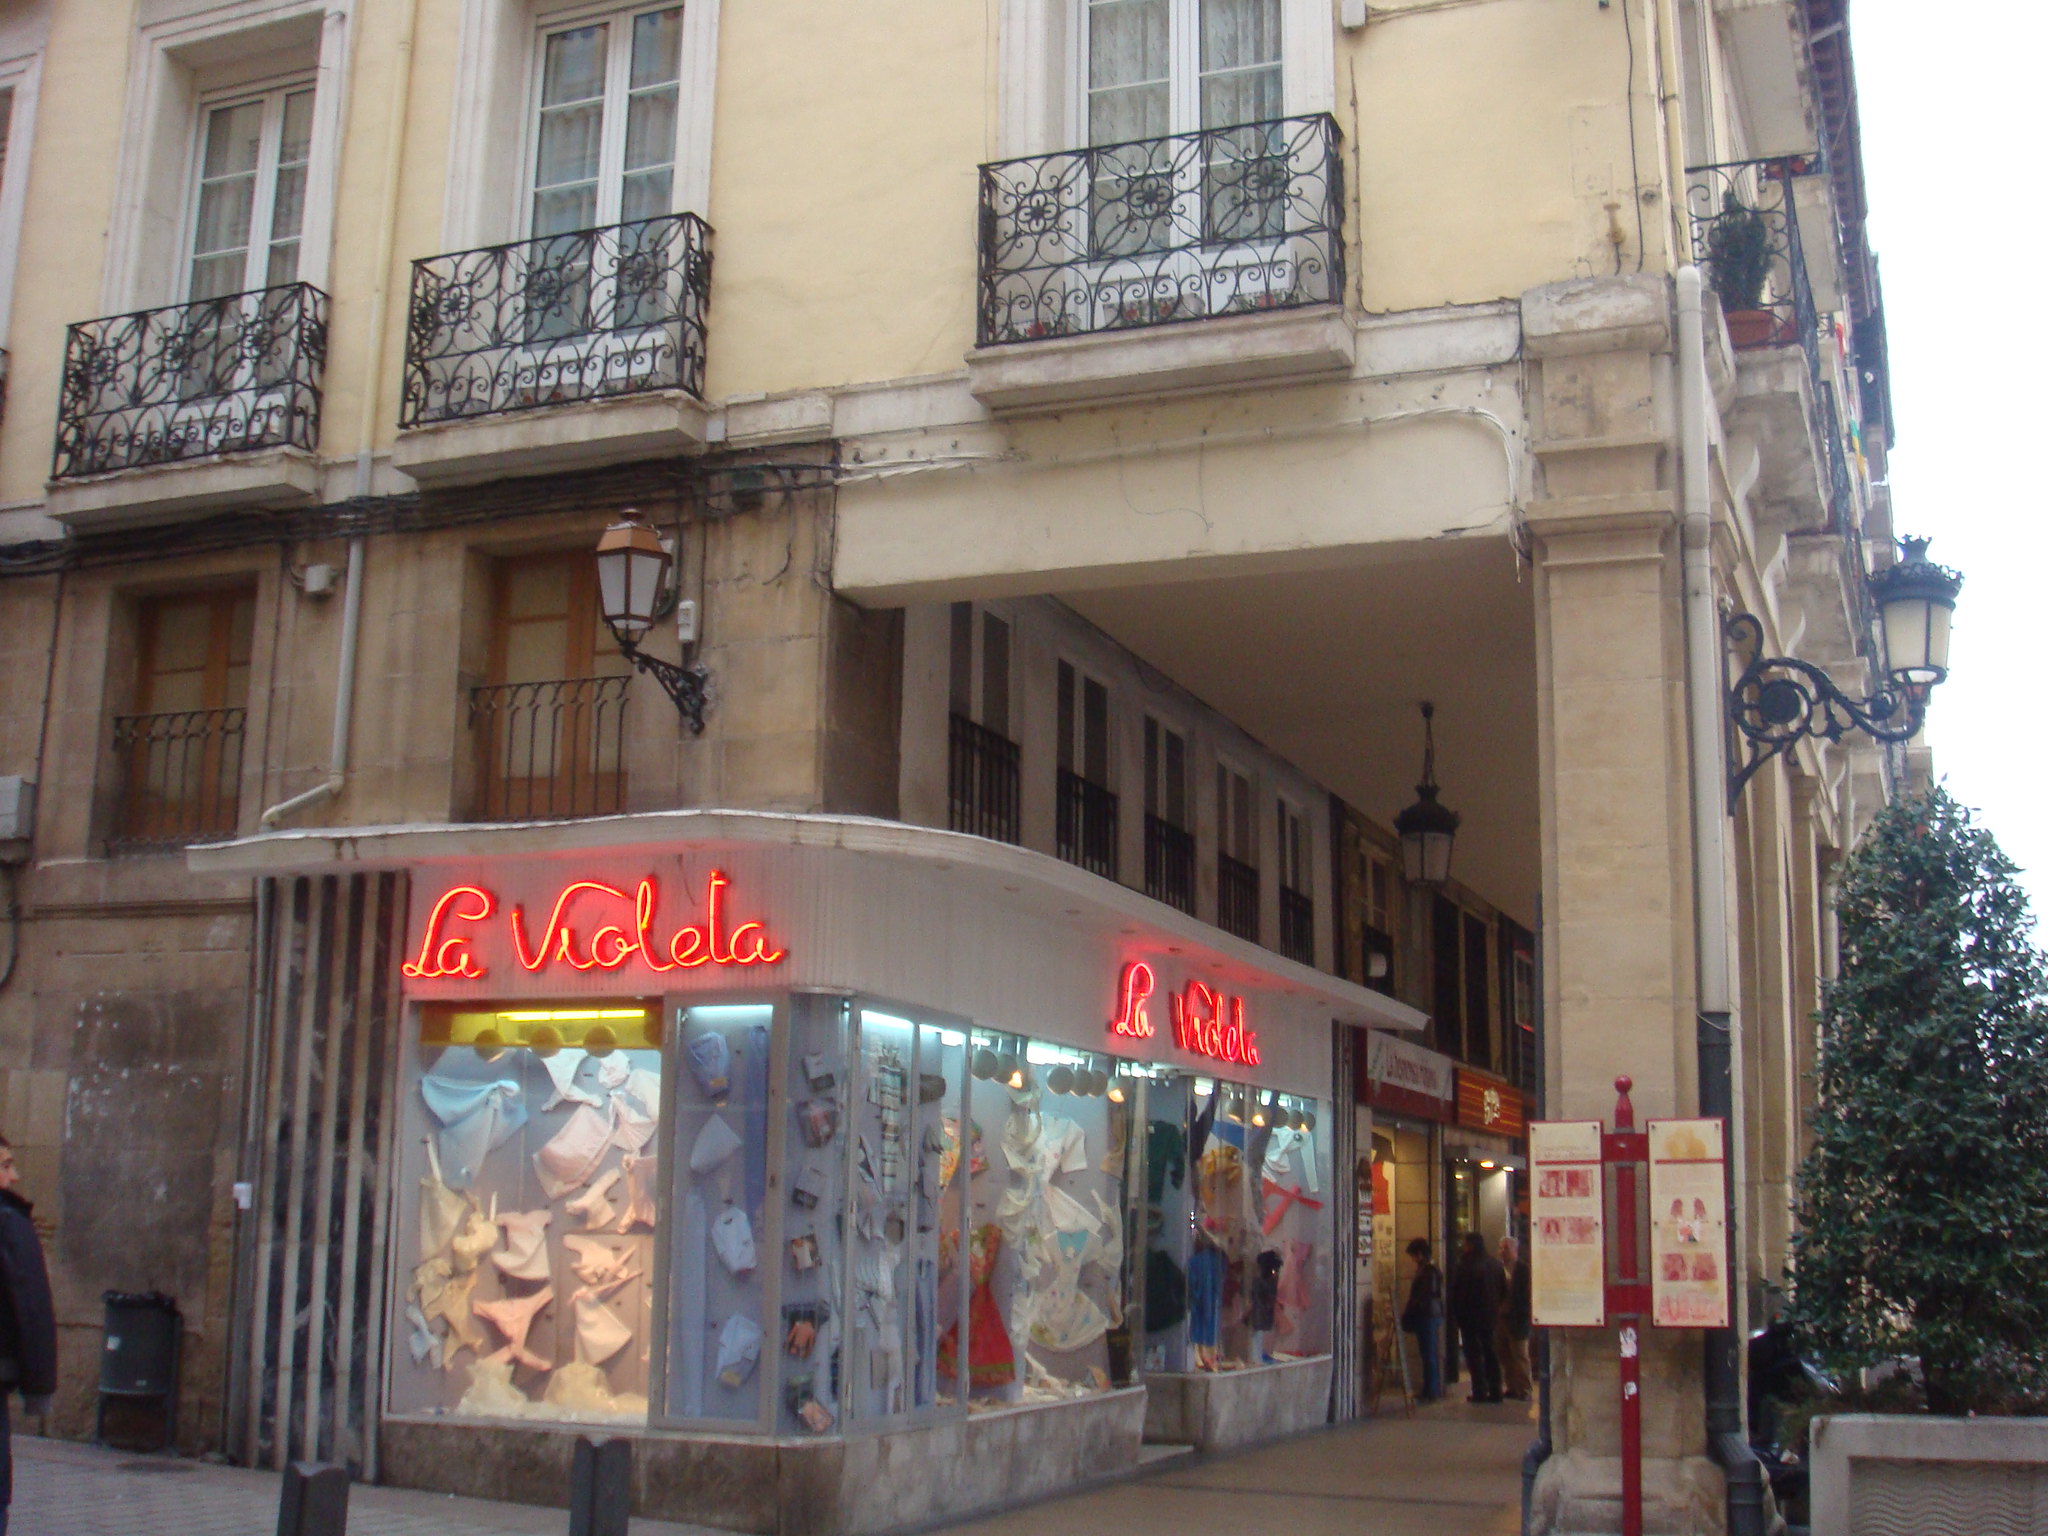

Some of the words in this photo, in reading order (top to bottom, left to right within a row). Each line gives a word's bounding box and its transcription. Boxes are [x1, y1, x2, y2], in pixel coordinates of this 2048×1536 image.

[401, 883, 491, 979] La
[510, 869, 785, 973] Violeta
[1113, 961, 1157, 1039] La
[1177, 980, 1262, 1066] Violeta
